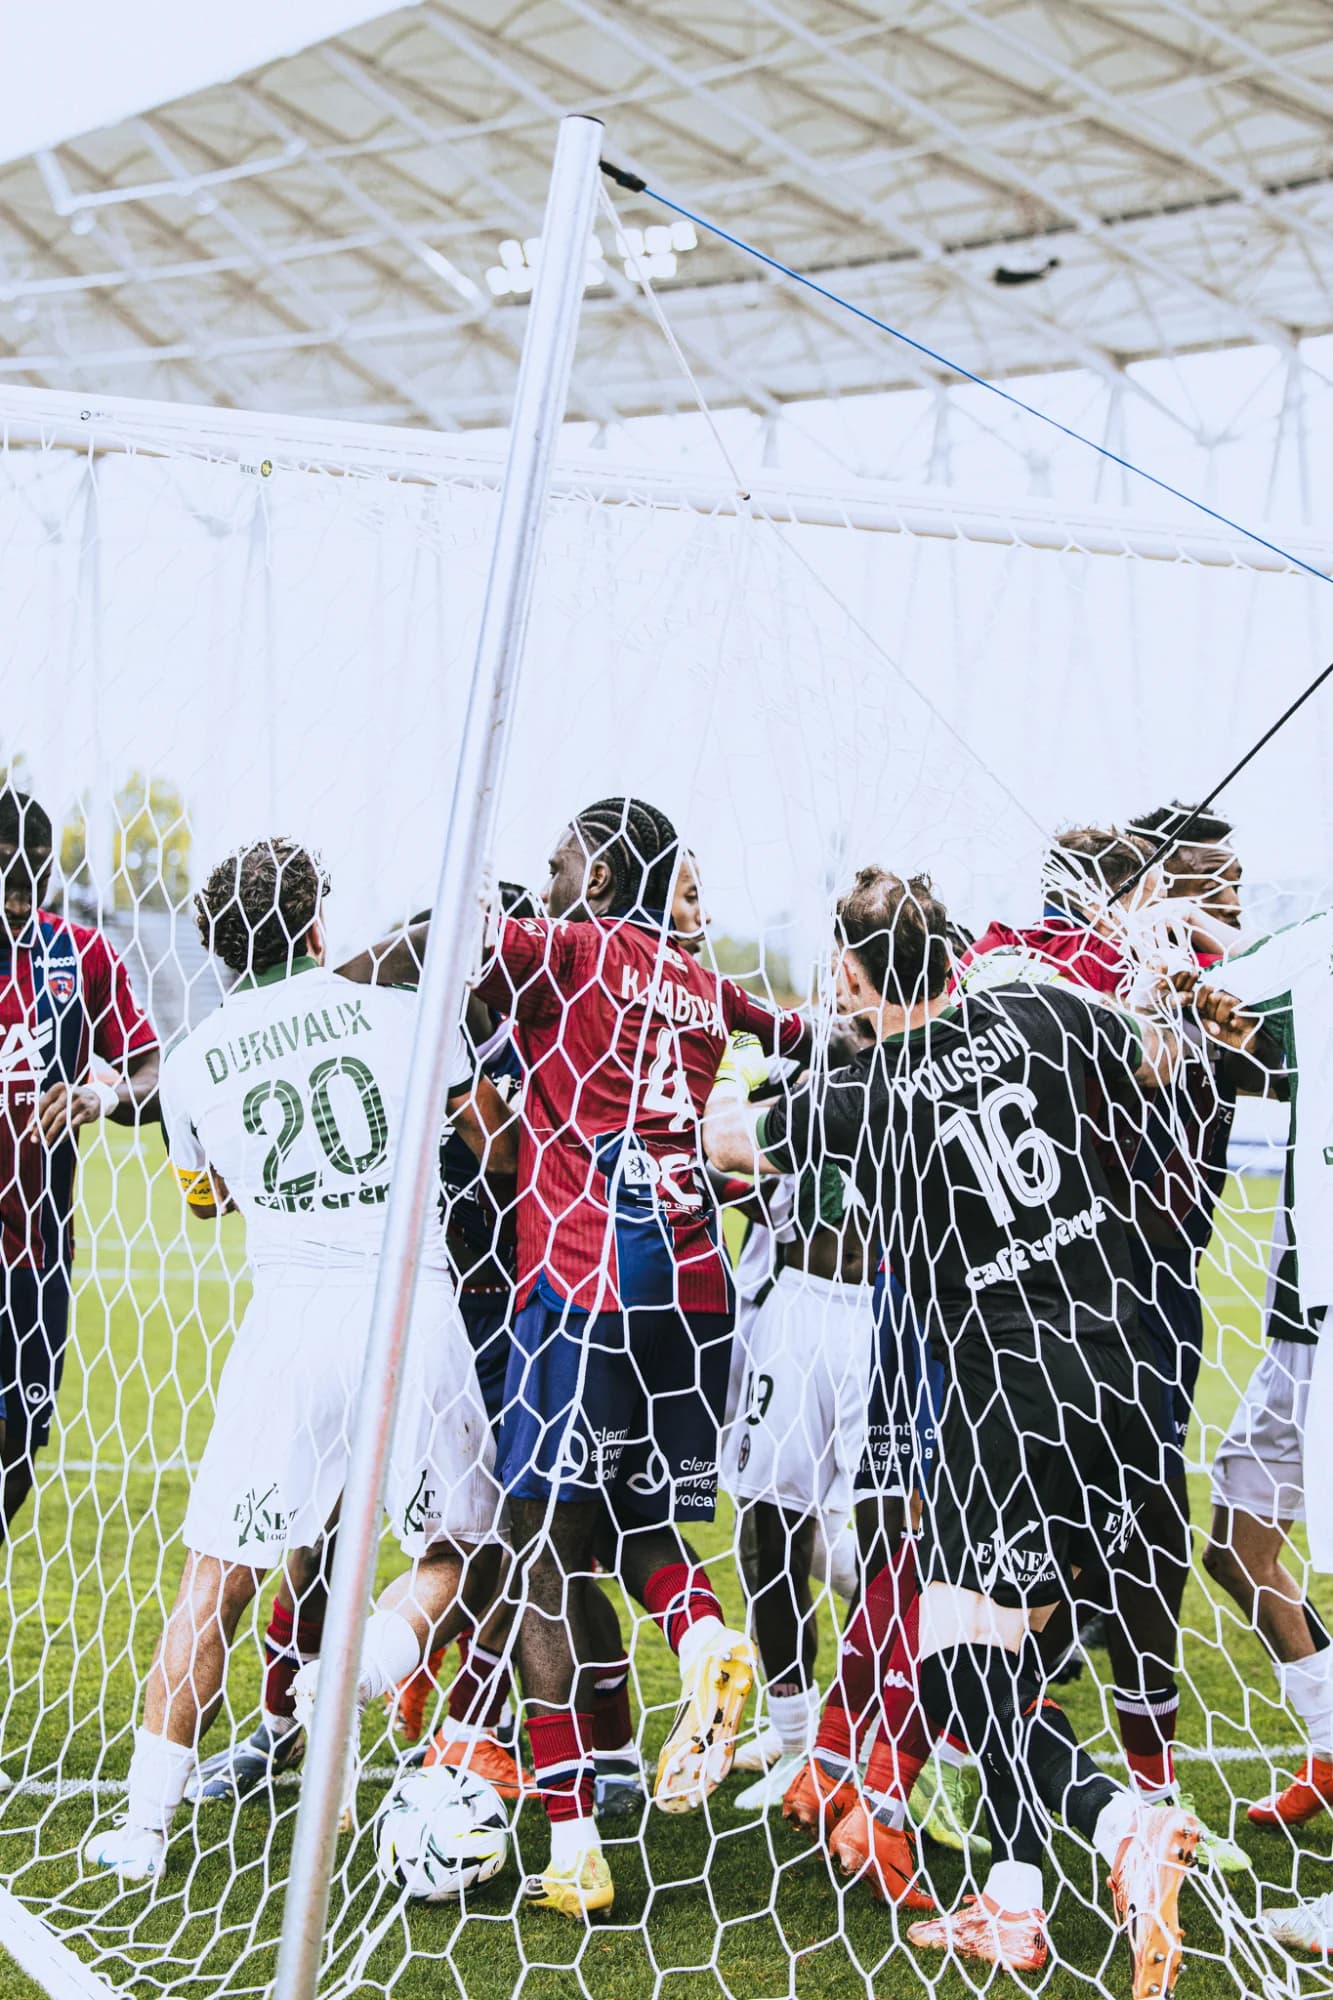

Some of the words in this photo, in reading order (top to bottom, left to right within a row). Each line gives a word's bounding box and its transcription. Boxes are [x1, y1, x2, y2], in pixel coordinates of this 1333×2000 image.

[205, 1000, 372, 1084] DURIVAUX
[891, 1023, 1030, 1111] POUSSIN
[243, 1056, 389, 1194] 20
[938, 1083, 1061, 1227] 16
[674, 1492, 717, 1507] volca
